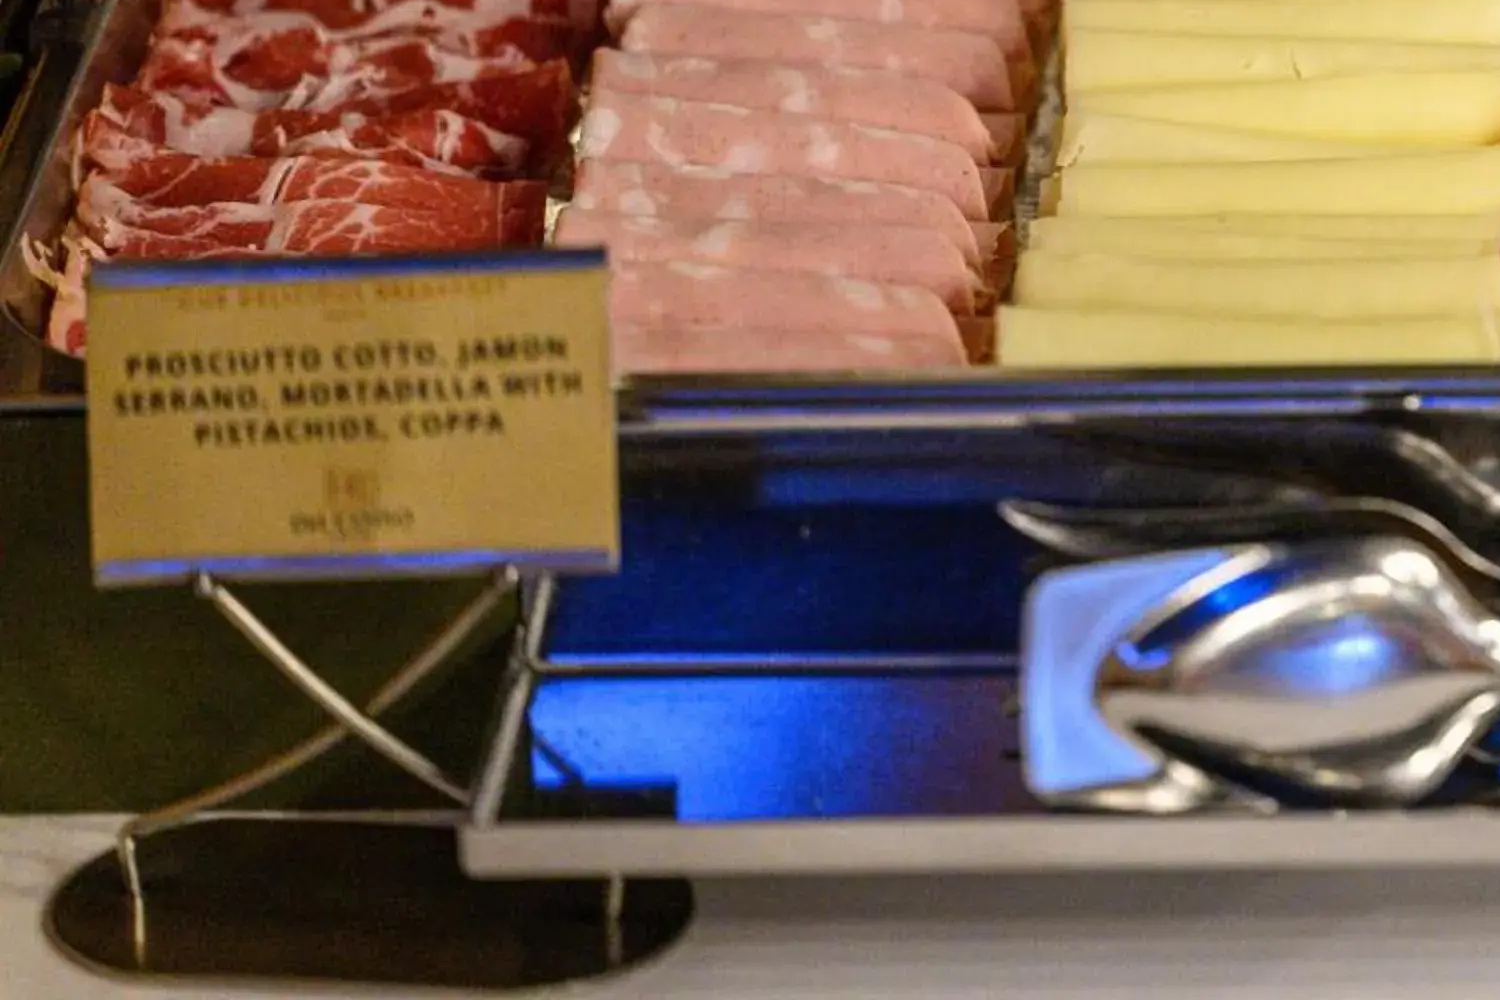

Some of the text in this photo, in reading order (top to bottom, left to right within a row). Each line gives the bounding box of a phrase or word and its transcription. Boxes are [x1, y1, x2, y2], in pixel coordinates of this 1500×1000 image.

[125, 343, 322, 379] PROSCIUTTO
[281, 373, 491, 406] MORTADELLA
[501, 371, 582, 399] WITH
[400, 409, 504, 438] COPPA
